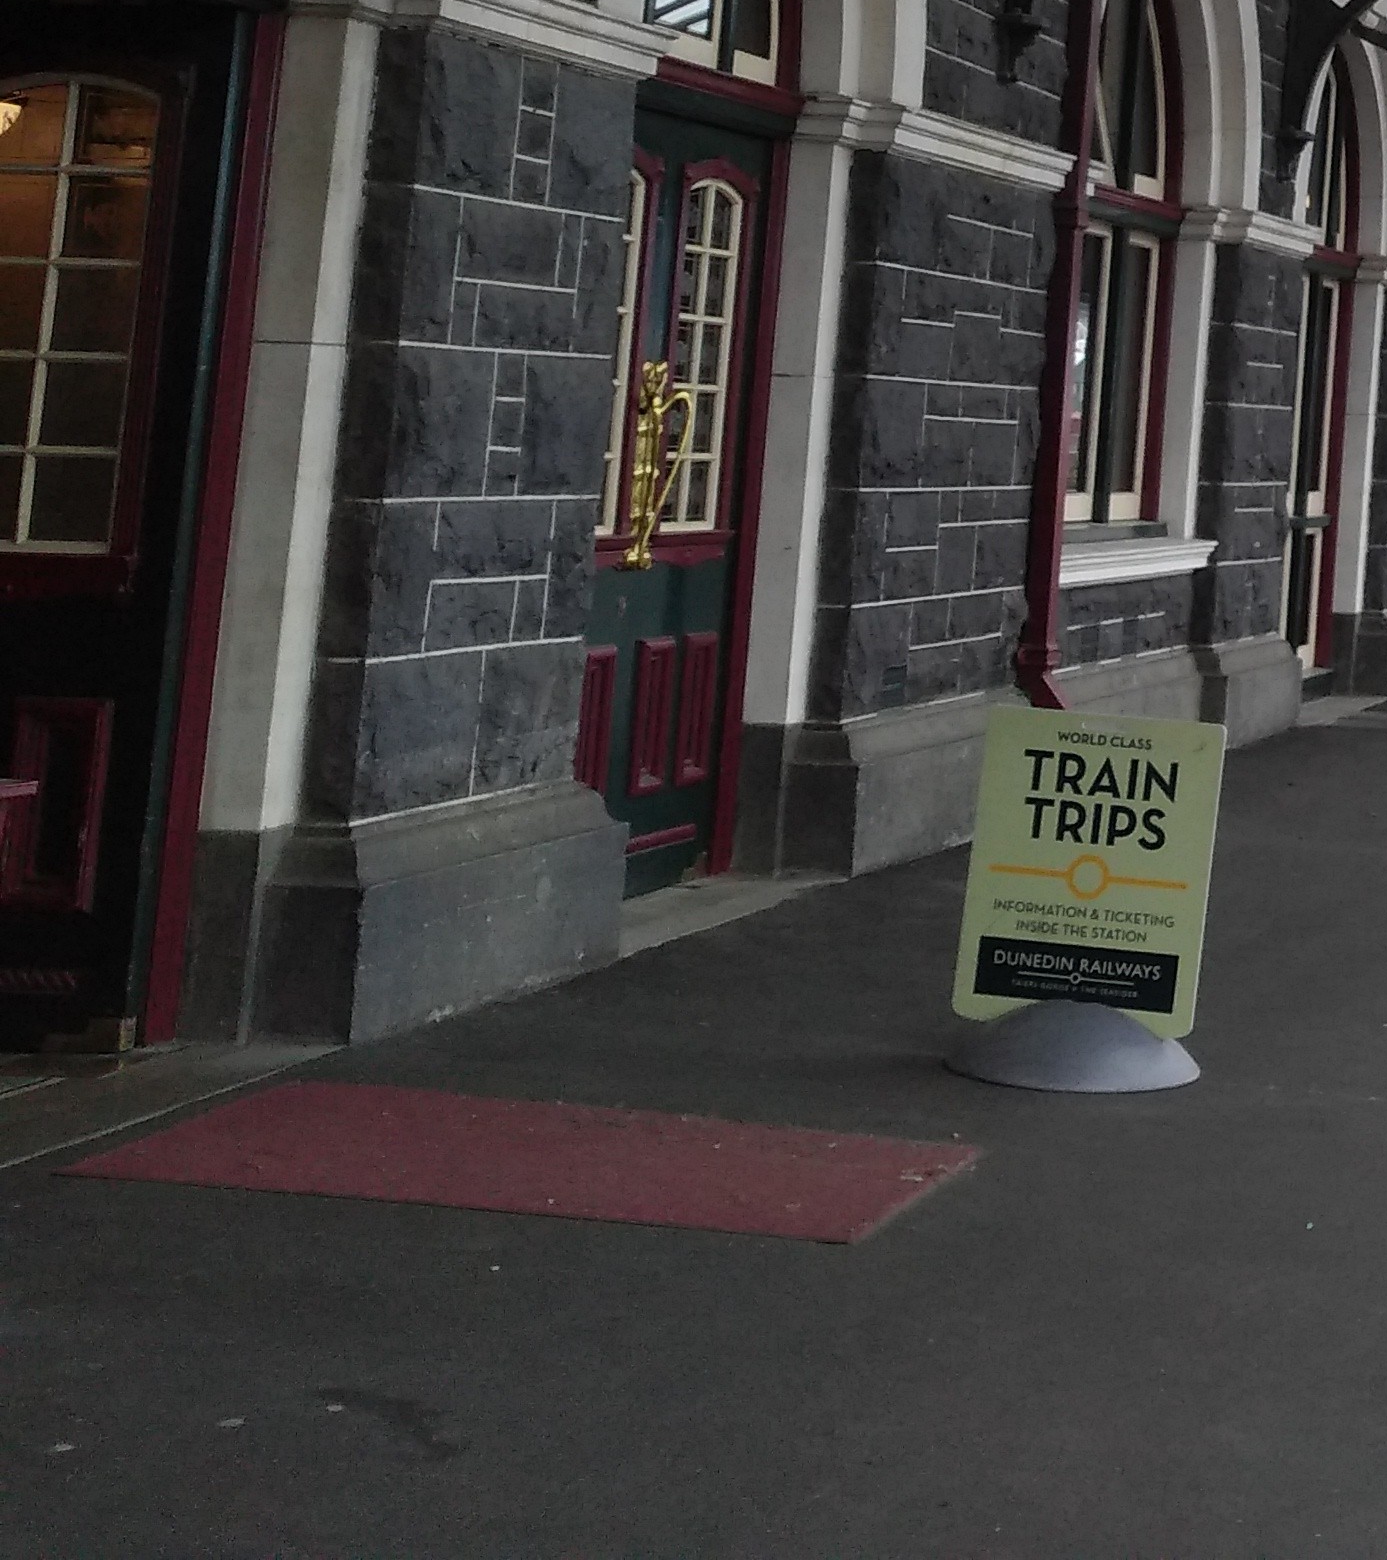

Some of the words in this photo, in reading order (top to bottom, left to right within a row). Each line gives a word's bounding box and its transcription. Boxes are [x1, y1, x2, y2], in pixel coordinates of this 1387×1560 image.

[1057, 731, 1107, 746] WORLD
[1110, 736, 1152, 750] CLASS
[1024, 749, 1179, 803] TRAIN
[1025, 797, 1166, 850] TRIPS
[993, 898, 1087, 919] INFORMATION
[1089, 908, 1099, 921] &
[1104, 909, 1175, 928] TICKETING
[1016, 920, 1058, 935] INSIDE
[1063, 924, 1087, 938] THE
[1092, 927, 1148, 942] STATION
[993, 949, 1074, 971] DUNEDIN
[1079, 958, 1161, 981] RAILWAYS
